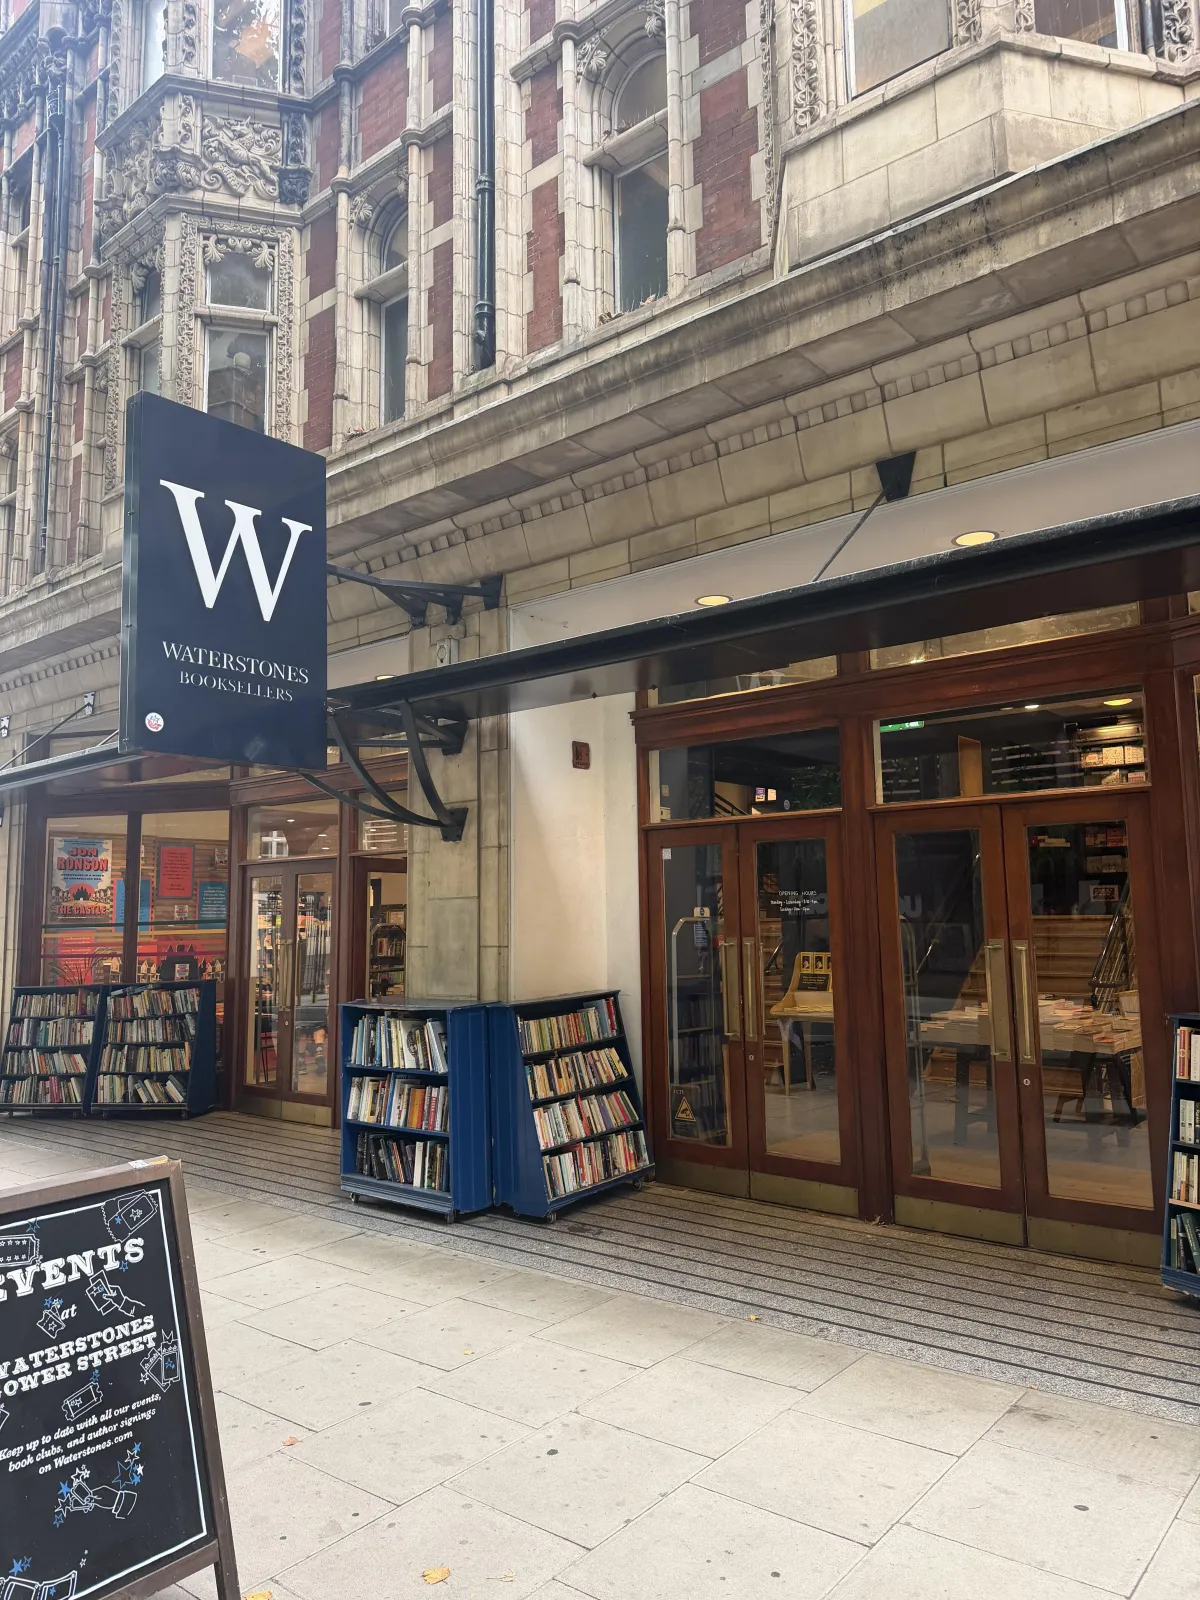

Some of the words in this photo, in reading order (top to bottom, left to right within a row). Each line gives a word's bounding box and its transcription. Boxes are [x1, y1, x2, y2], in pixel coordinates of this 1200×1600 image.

[160, 479, 312, 622] W
[162, 641, 309, 684] WATERSTONES
[179, 671, 294, 702] BOOKSELLERS
[57, 857, 109, 871] RONSON
[68, 847, 99, 857] JON
[55, 905, 72, 914] THE
[74, 906, 106, 915] CASTLE
[0, 1237, 145, 1301] VENTS
[61, 1303, 77, 1320] at
[0, 1362, 73, 1399] OWER
[77, 1331, 157, 1371] STREET
[0, 1445, 24, 1461] Keep
[26, 1439, 39, 1452] up
[41, 1435, 52, 1445] to
[53, 1426, 75, 1440] date
[76, 1414, 98, 1431] with
[100, 1408, 112, 1422] all
[113, 1404, 130, 1417] our
[131, 1393, 161, 1410] events,
[8, 1454, 34, 1473] book
[36, 1444, 64, 1462] clubs,
[66, 1433, 86, 1449] and
[87, 1423, 118, 1441] author
[120, 1408, 156, 1427] signings
[38, 1463, 52, 1475] on
[53, 1430, 133, 1469] Waterstones.com
